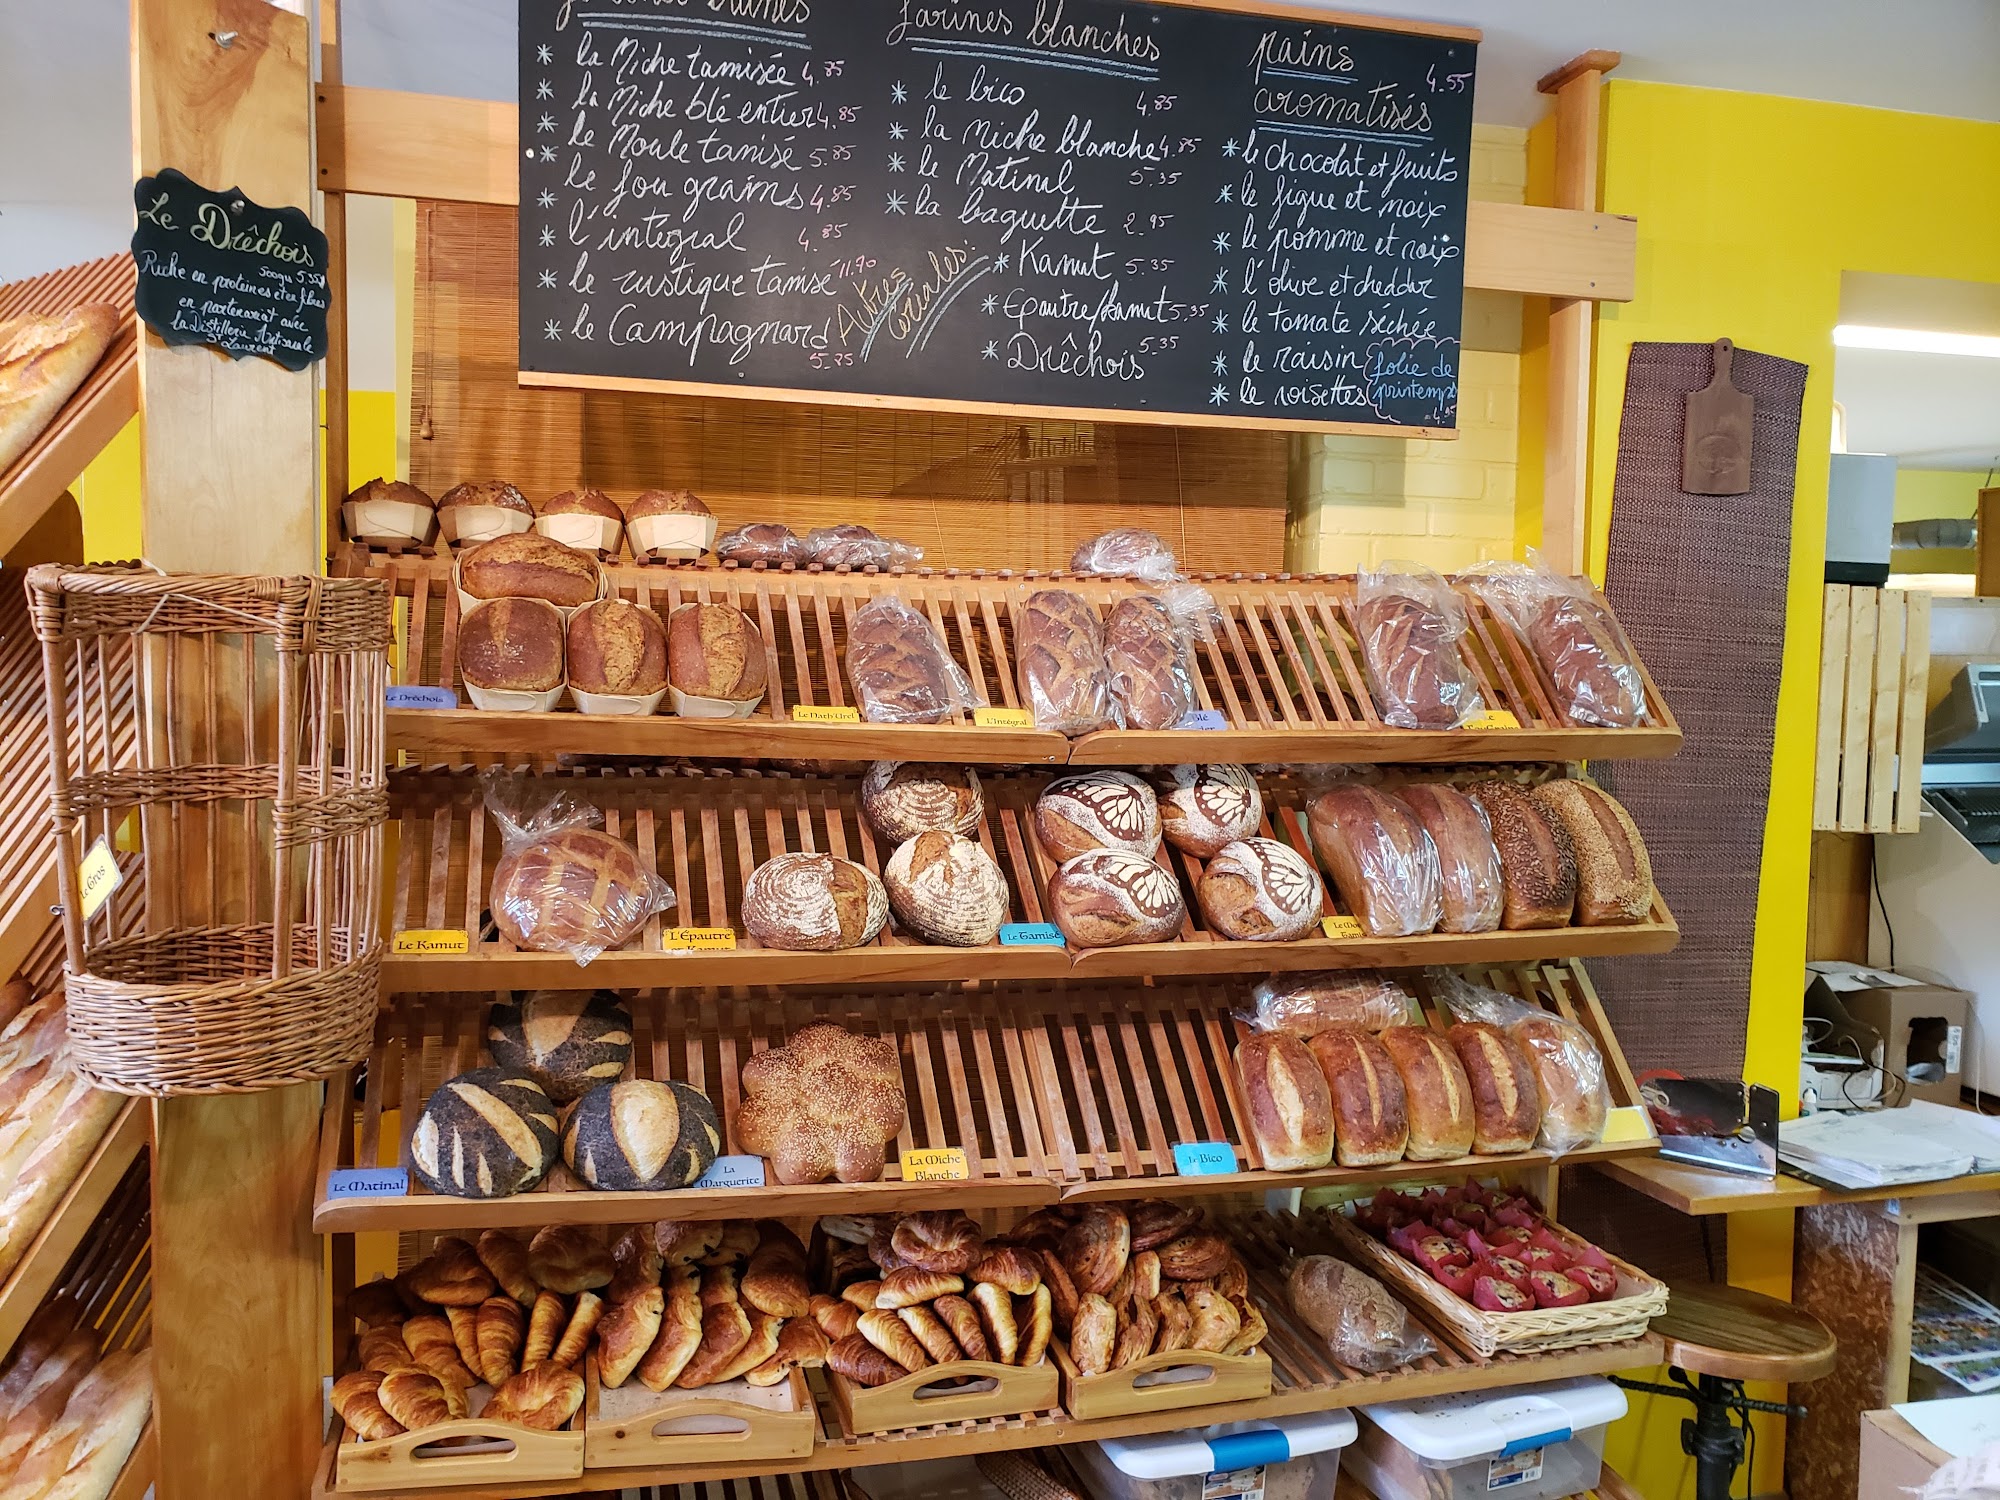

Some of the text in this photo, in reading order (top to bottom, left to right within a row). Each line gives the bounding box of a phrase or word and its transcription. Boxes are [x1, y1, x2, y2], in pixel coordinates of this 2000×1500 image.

[886, 0, 1160, 61] farines blanches
[576, 31, 603, 67] la
[609, 37, 681, 83] Miche
[687, 45, 797, 86] tamisée
[1247, 28, 1355, 85] pains
[572, 71, 600, 109] la
[607, 81, 677, 126] Miche
[685, 83, 731, 124] blé
[740, 91, 816, 128] entier
[925, 61, 952, 100] le
[966, 64, 1026, 105] bico
[1254, 80, 1434, 133] aromatisés
[568, 110, 596, 147] le
[607, 123, 691, 164] Moule
[808, 145, 857, 168] 5.85
[920, 104, 952, 141] la
[962, 108, 1046, 152] Miche
[1056, 115, 1160, 161] blanche
[917, 144, 939, 178] le
[1241, 128, 1257, 165] le
[1367, 152, 1390, 181] et
[1381, 147, 1459, 199] fruits
[564, 152, 858, 222] le fou grains 4.85
[1241, 169, 1447, 231] le figue et noix
[138, 192, 315, 268] Le Drêchois
[914, 191, 942, 216] la
[958, 195, 1107, 243] baguette
[1019, 236, 1116, 281] Kamut
[1241, 213, 1461, 273] le pomme et noix
[139, 250, 187, 280] Riche
[191, 271, 208, 285] en
[274, 286, 288, 300] et
[568, 251, 597, 295] le
[612, 258, 747, 316] rustique
[1329, 265, 1356, 297] et
[1353, 264, 1439, 299] cheddar
[170, 310, 315, 354] la Distillerie Artisanale
[178, 296, 309, 332] en partenariat avec
[571, 303, 596, 341] le
[608, 303, 831, 367] Campagnard
[1241, 299, 1438, 339] le tomate séchée
[222, 335, 277, 356] Laurent
[1006, 330, 1147, 381] Drêchois
[1242, 340, 1365, 374] le raisin
[1370, 351, 1457, 386] folie de
[1239, 374, 1368, 407] le noisettes
[1372, 379, 1459, 412] printemps
[385, 694, 397, 702] Le
[86, 865, 106, 891] Gros
[397, 940, 465, 951] Le Kamut
[669, 929, 731, 943] L'Épautre
[1007, 930, 1062, 941] Le Tamisé
[723, 1165, 735, 1174] La
[909, 1154, 961, 1166] La Miche
[914, 1170, 960, 1181] Blanche
[1199, 1153, 1223, 1163] Bico
[333, 1178, 404, 1192] Le Matinal
[700, 1176, 760, 1188] Marguerite
